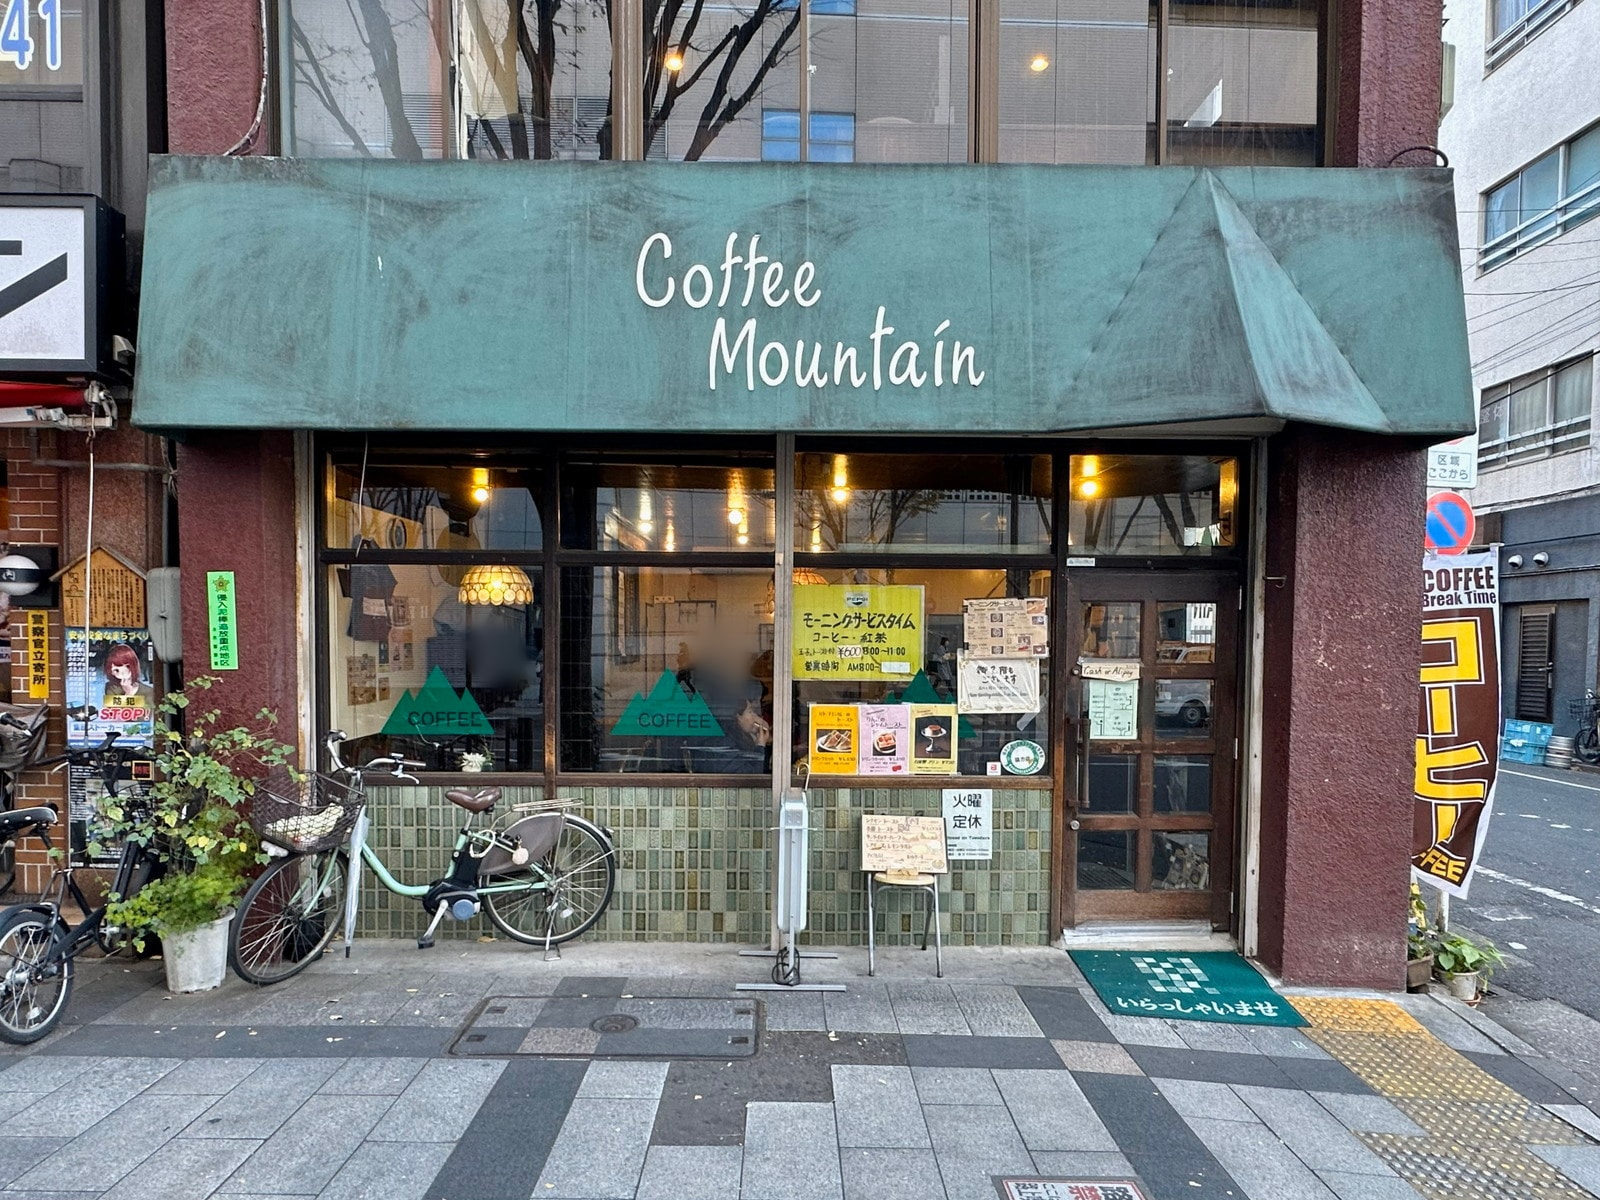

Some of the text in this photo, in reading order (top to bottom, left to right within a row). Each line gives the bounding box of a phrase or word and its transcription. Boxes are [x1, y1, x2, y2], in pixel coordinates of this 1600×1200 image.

[636, 232, 821, 308] Coffee
[709, 305, 985, 391] Mountain
[1437, 454, 1461, 466] 区域
[1428, 467, 1469, 480] ここから
[1423, 566, 1495, 593] COFFEE
[968, 600, 1014, 608] モーニングサービス
[1423, 590, 1497, 608] Break Time
[803, 612, 916, 630] モーニングサービスタイム
[31, 613, 46, 685] 警察官立寄所
[1084, 666, 1103, 675] Cash
[1112, 666, 1134, 678] Alipay
[112, 696, 136, 706] 防犯
[407, 711, 483, 727] COFFEE
[637, 712, 711, 729] COFFEE
[952, 793, 982, 808] 火曜
[952, 814, 982, 829] 定休
[1419, 849, 1466, 883] FEE
[1116, 996, 1279, 1017] いらっしゃいませ
